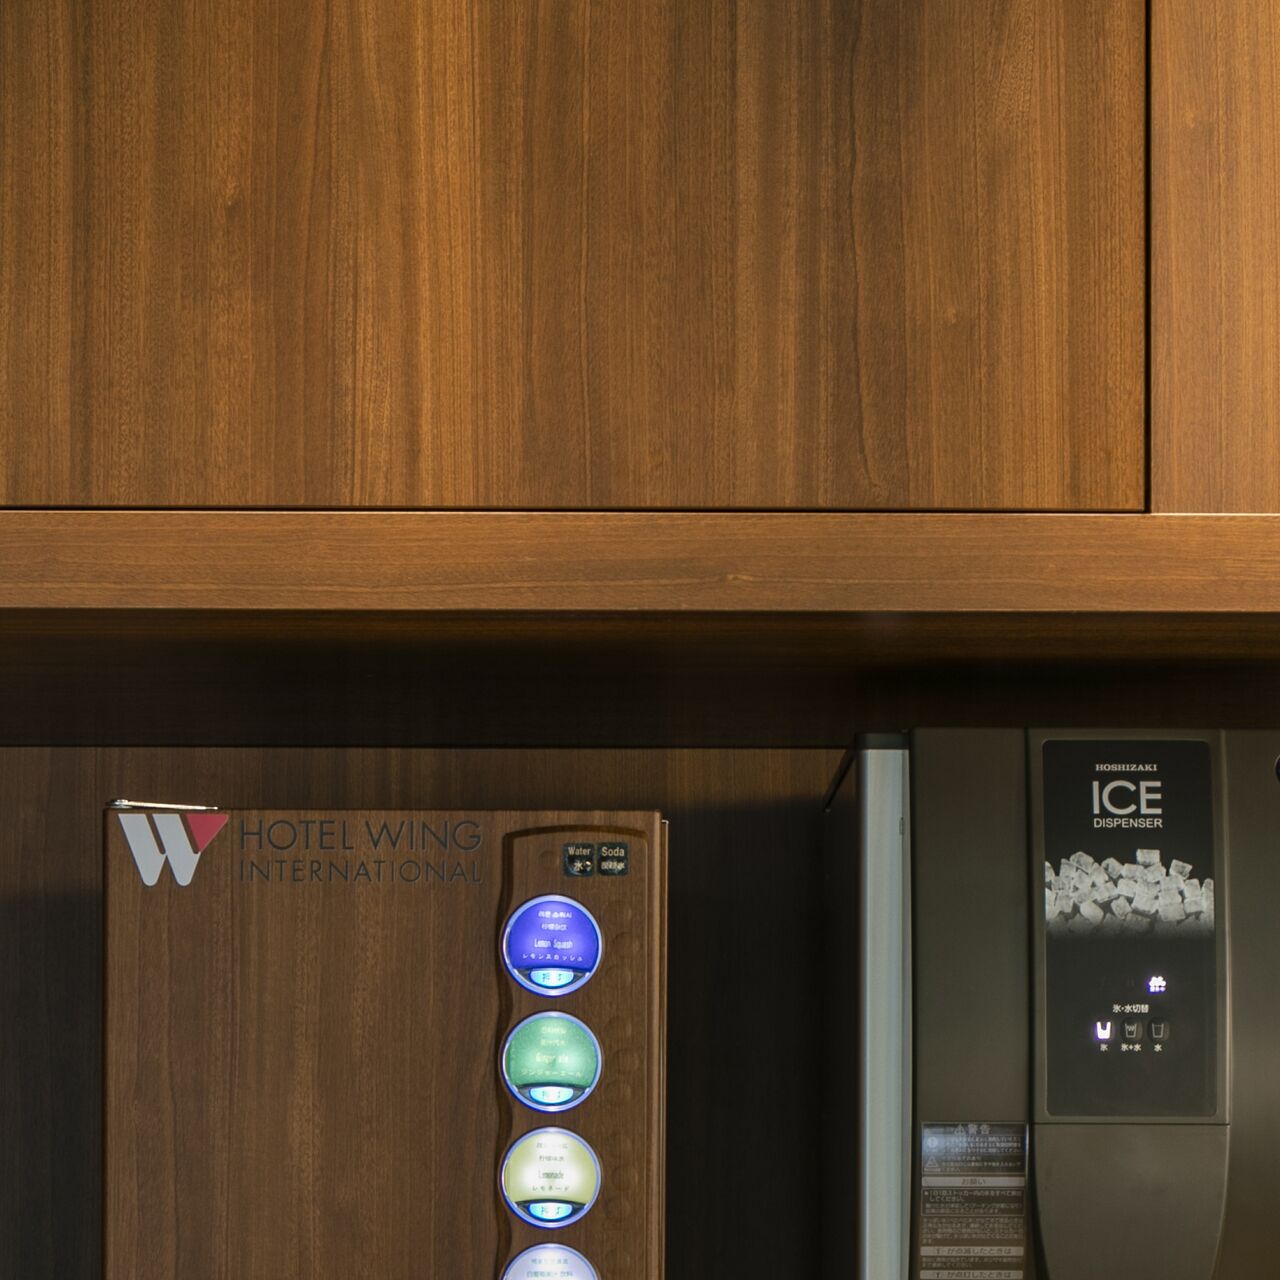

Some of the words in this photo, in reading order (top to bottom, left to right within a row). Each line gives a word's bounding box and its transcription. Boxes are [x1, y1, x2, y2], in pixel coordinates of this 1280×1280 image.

[1093, 780, 1162, 815] ICE
[1094, 818, 1163, 828] DISPENSER
[240, 820, 354, 850] HOTEL
[365, 820, 481, 851] WING
[568, 847, 590, 855] Water
[602, 846, 625, 856] Soda
[240, 860, 481, 883] INTERNATIONAL
